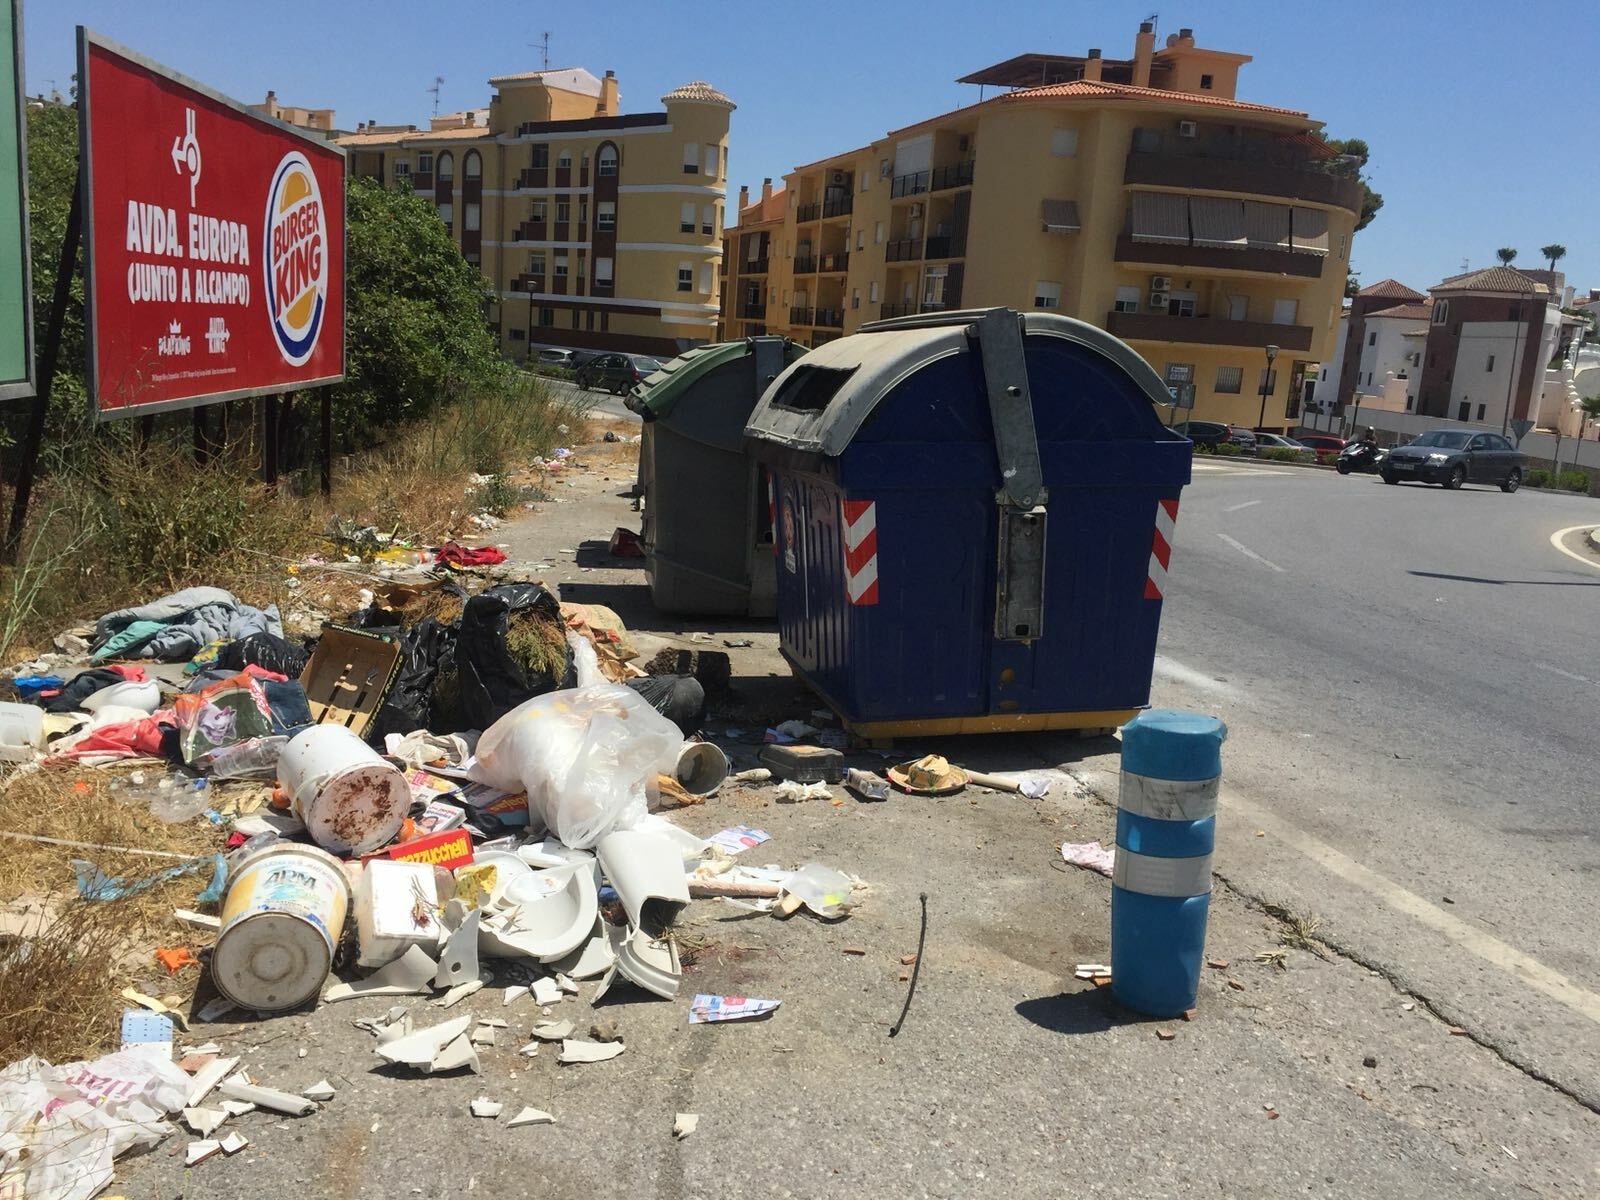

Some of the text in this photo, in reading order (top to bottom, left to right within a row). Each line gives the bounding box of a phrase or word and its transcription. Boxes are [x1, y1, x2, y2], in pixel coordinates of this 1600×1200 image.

[127, 200, 249, 266] AVDA. EUROPA
[274, 201, 319, 266] BURGER
[128, 262, 250, 308] (JUNTO A ALCAMPO)
[275, 234, 321, 319] KING
